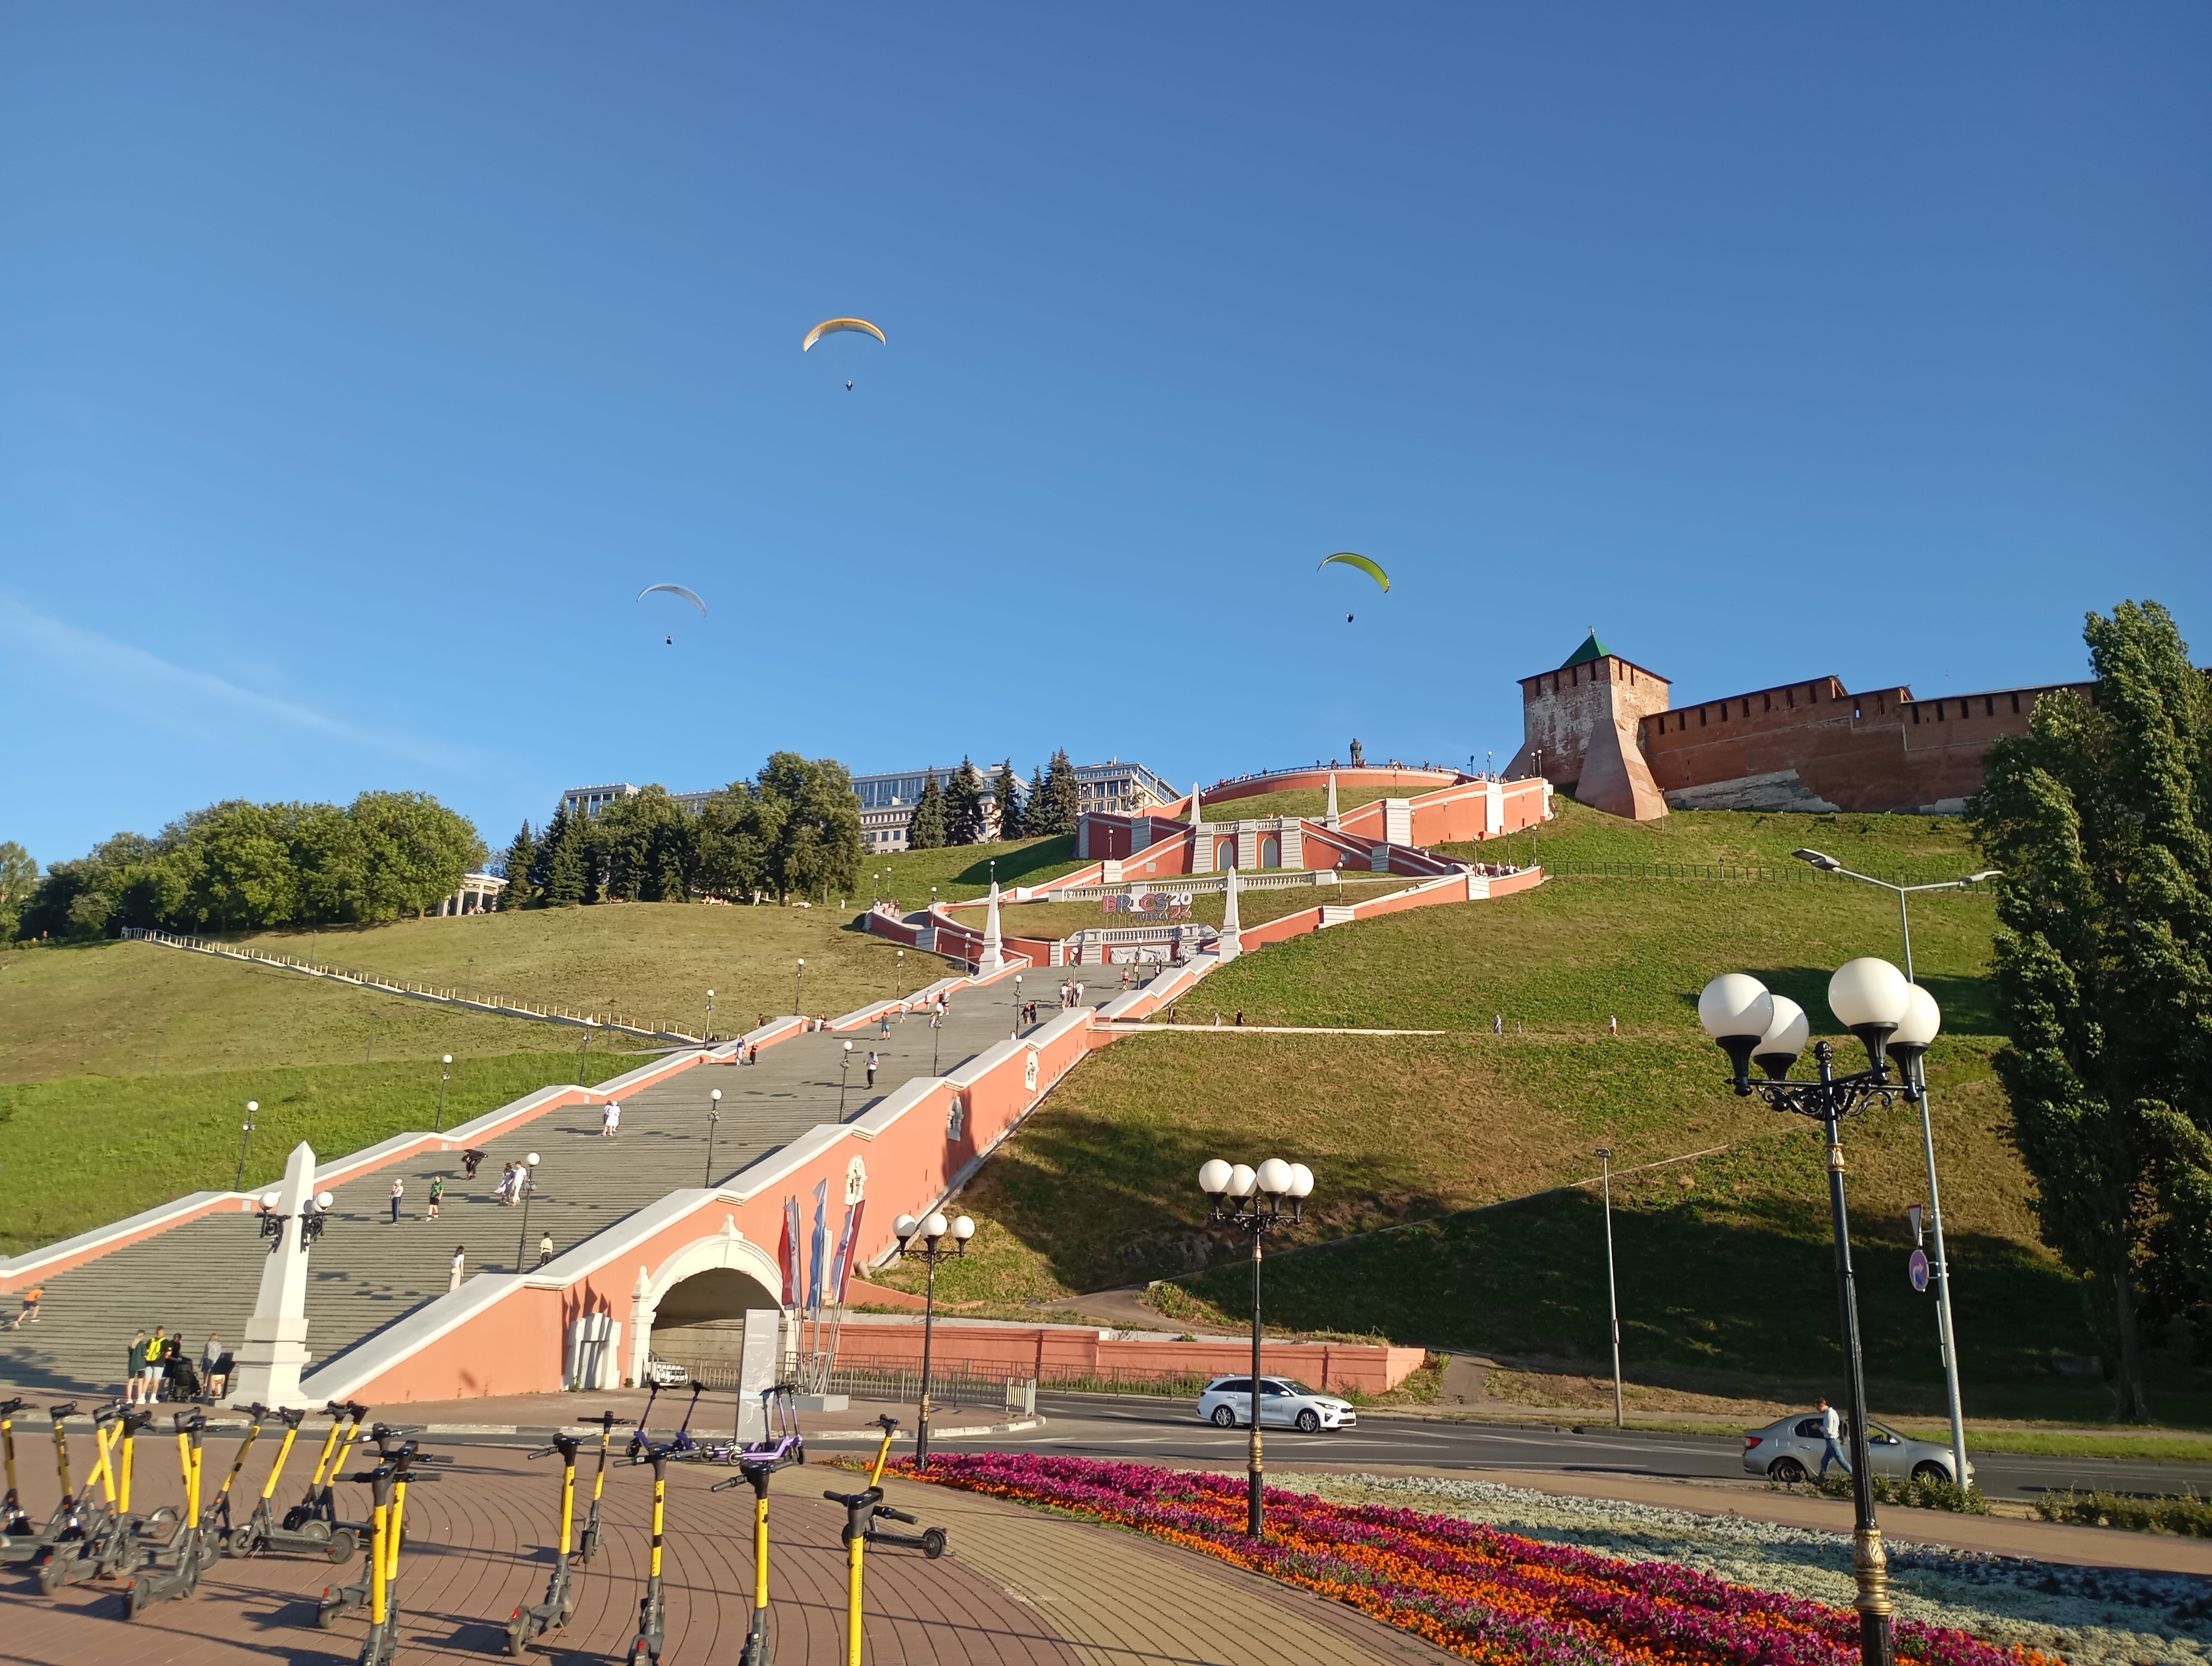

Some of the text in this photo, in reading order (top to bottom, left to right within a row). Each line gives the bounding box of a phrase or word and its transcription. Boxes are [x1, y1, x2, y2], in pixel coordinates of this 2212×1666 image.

[1102, 893, 1168, 913] BRICS
[1169, 892, 1193, 906] 20
[1169, 905, 1192, 919] 24
